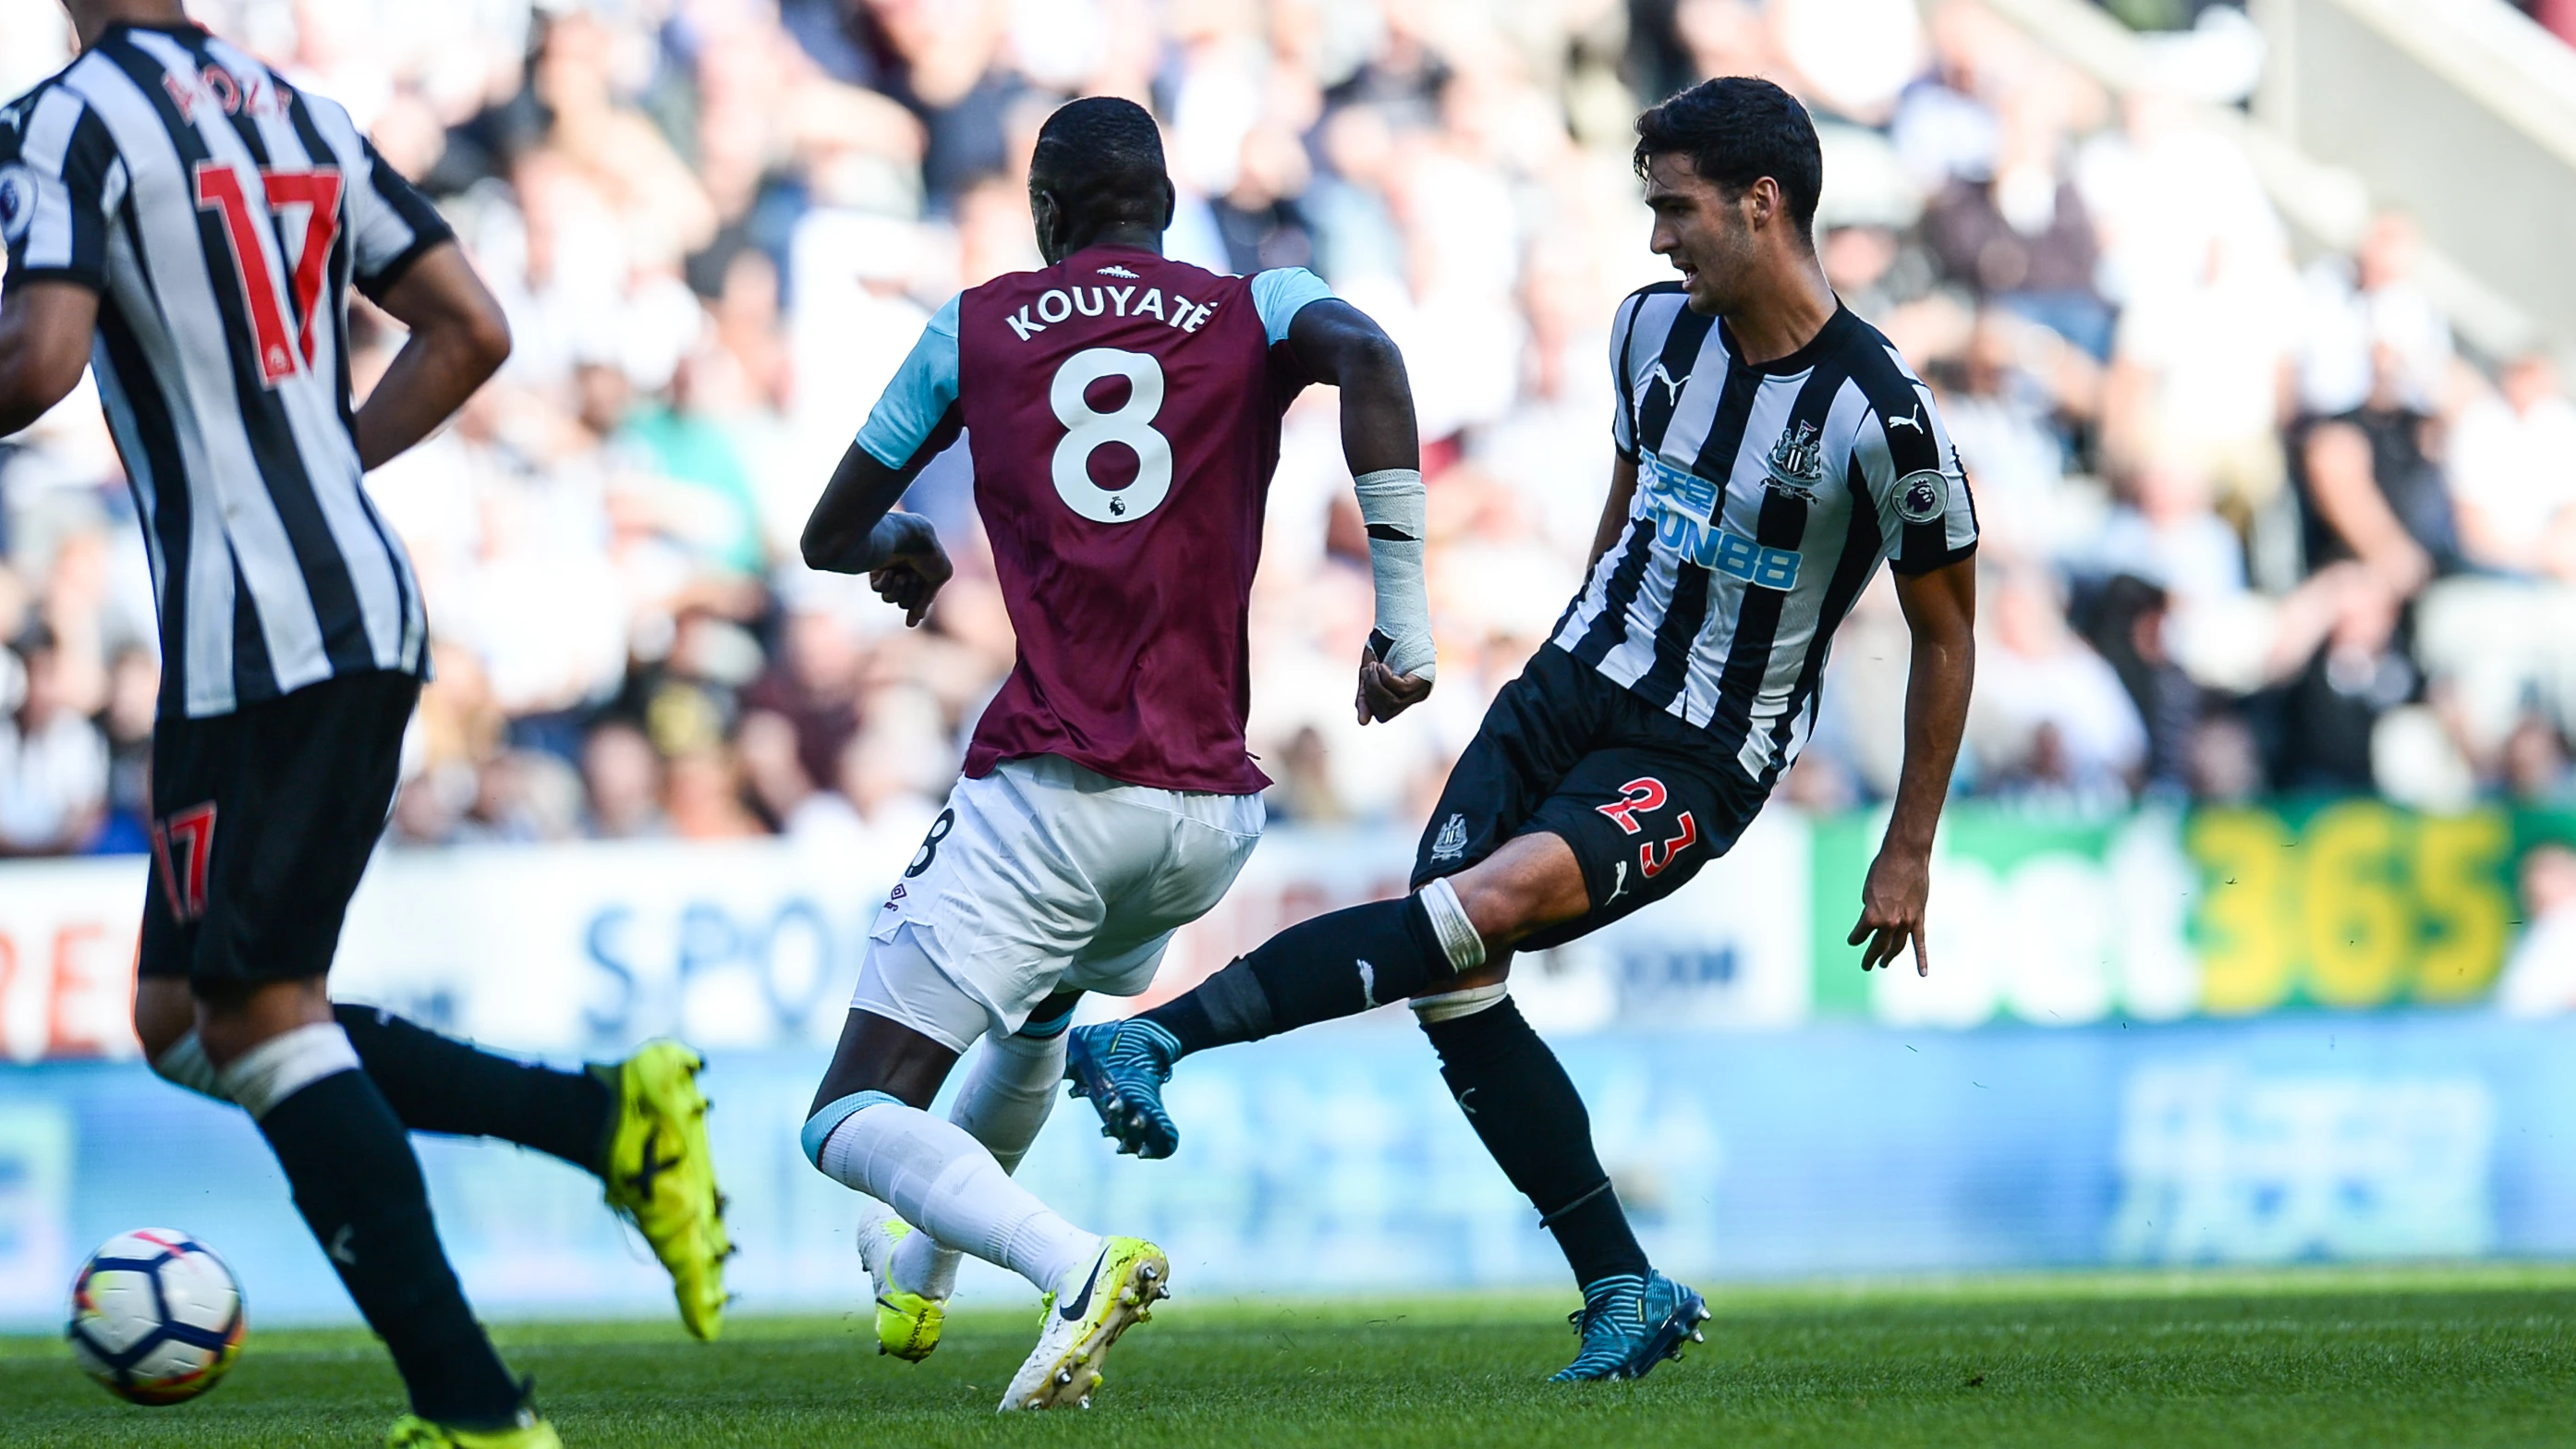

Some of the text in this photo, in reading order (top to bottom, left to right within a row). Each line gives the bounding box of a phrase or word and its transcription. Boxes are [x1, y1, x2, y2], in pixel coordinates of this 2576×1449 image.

[195, 161, 343, 390] 17
[1005, 286, 1218, 342] KOUYATÉ
[1051, 347, 1173, 523] 8
[154, 799, 217, 922] 17
[904, 808, 955, 878] 8
[1596, 776, 1696, 878] 23
[1865, 797, 2509, 1028] bet365
